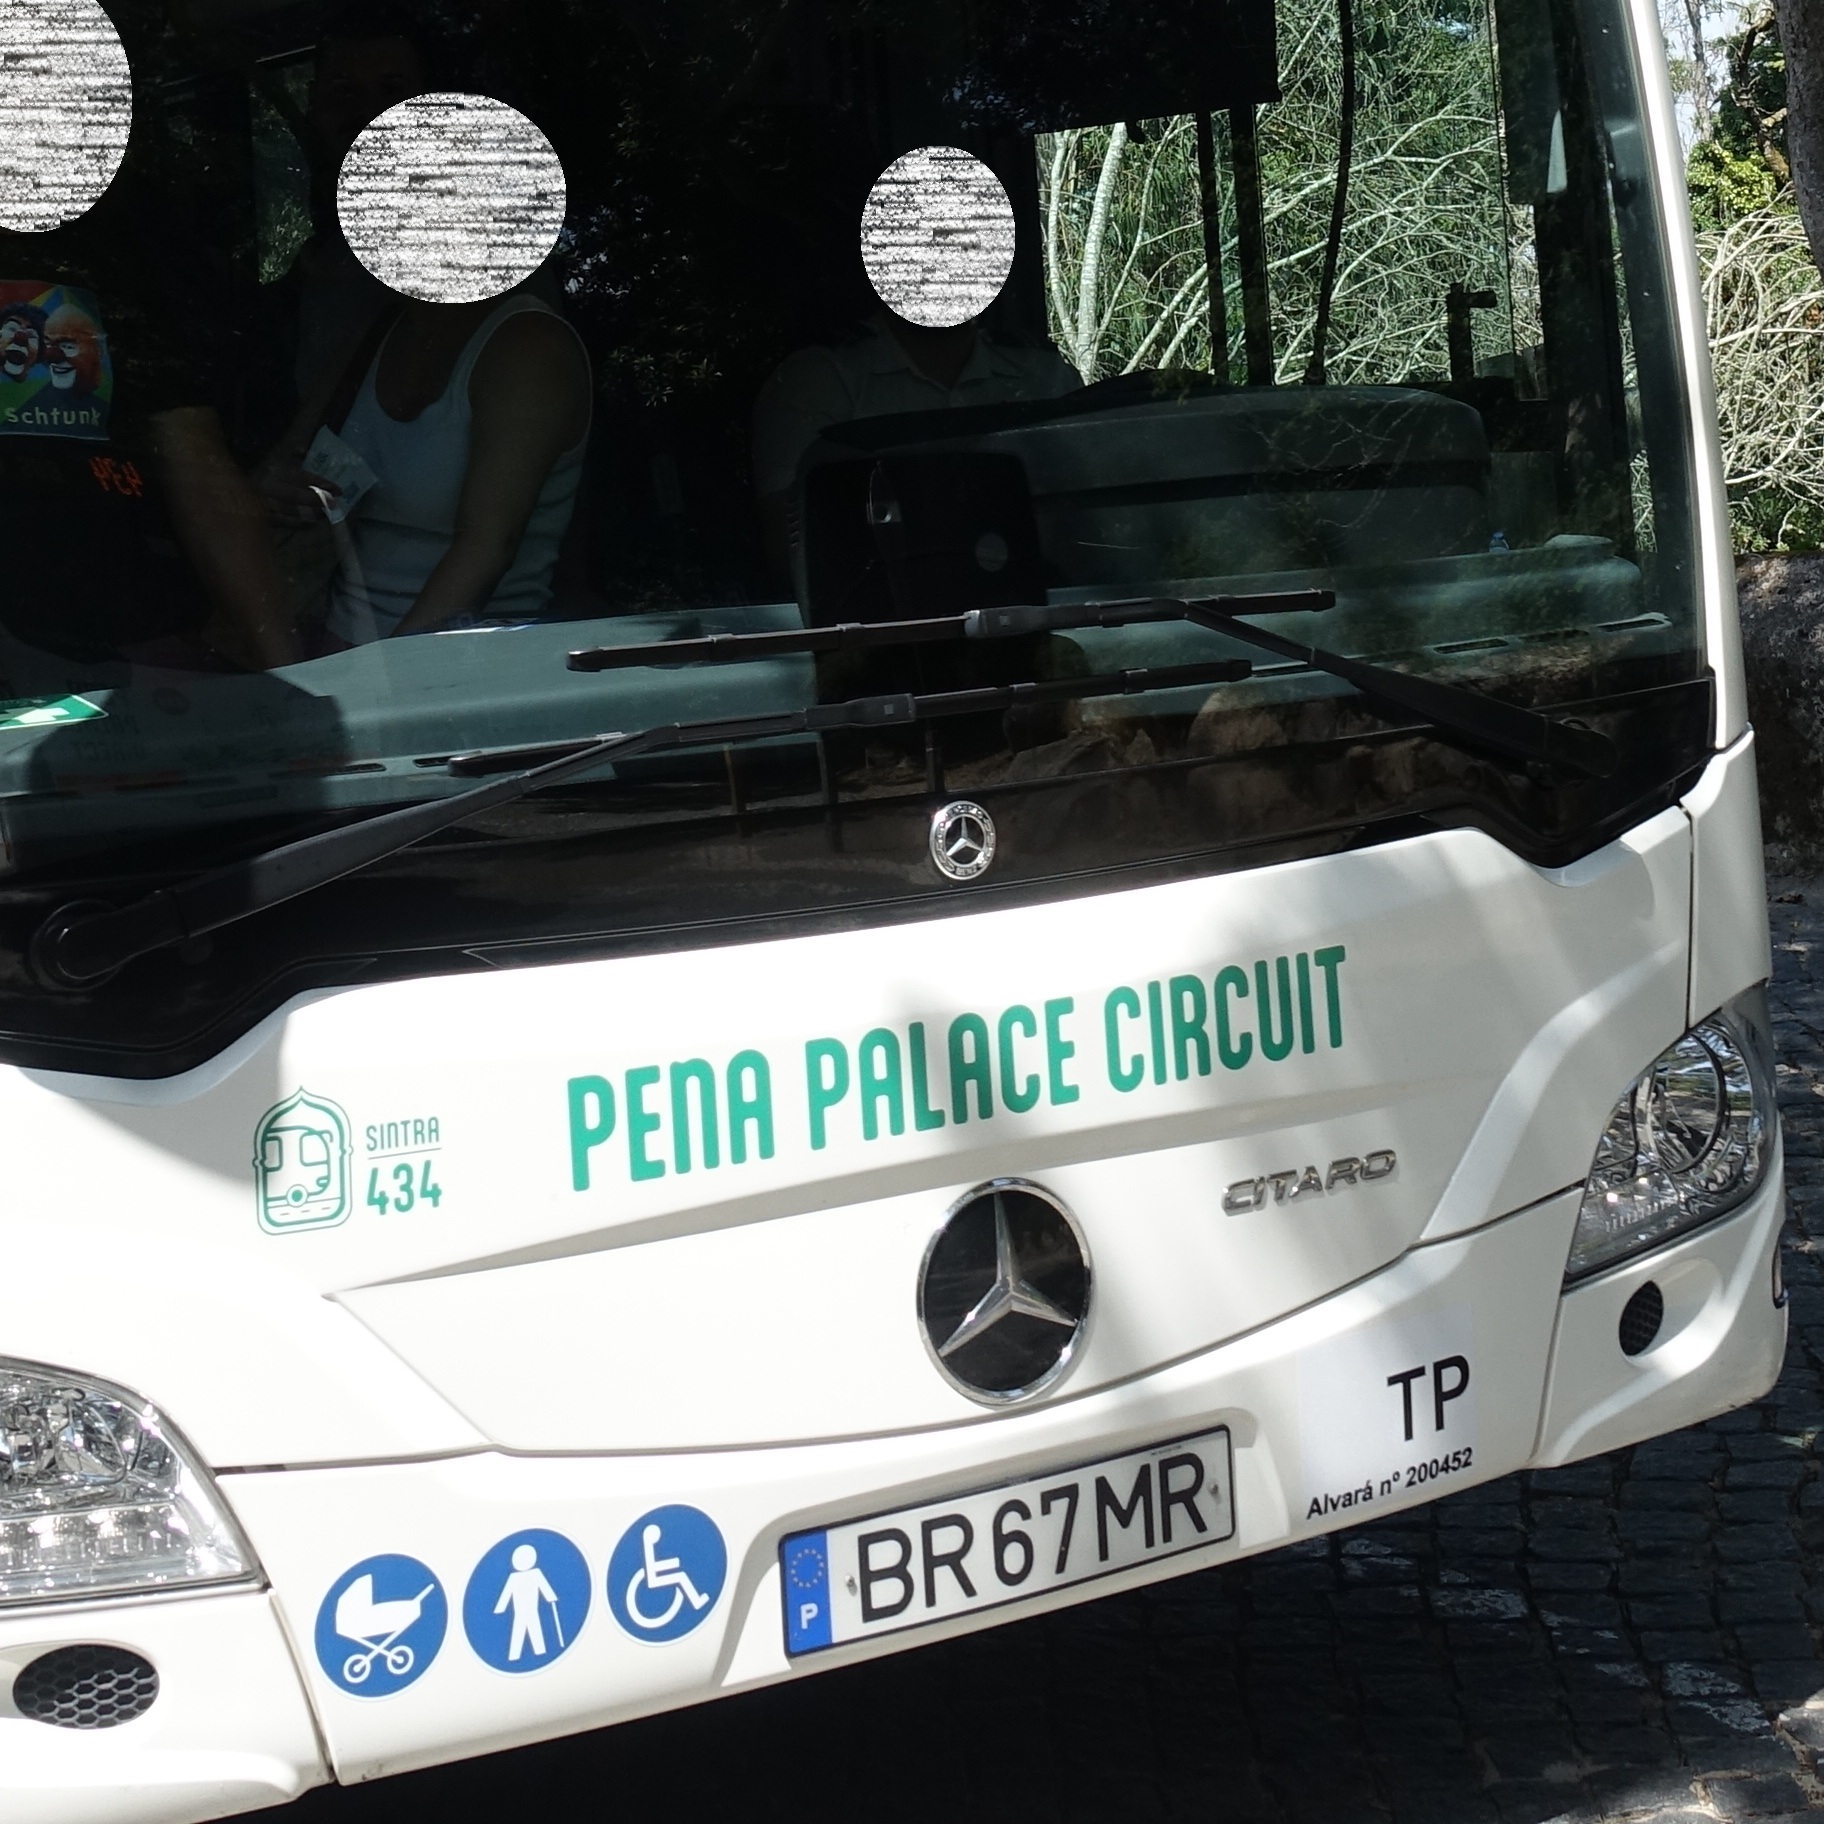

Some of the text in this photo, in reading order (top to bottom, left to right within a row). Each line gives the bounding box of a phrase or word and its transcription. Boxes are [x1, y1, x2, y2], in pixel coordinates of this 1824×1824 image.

[567, 944, 1346, 1193] PENA PALACE CIRCUIT
[366, 1116, 440, 1152] SINTRA
[366, 1159, 443, 1216] 434
[1222, 1149, 1397, 1213] CITARO
[1386, 1354, 1470, 1442] TP
[1307, 1477, 1374, 1520] Alvará
[1406, 1447, 1474, 1489] 200452
[800, 1602, 819, 1631] P
